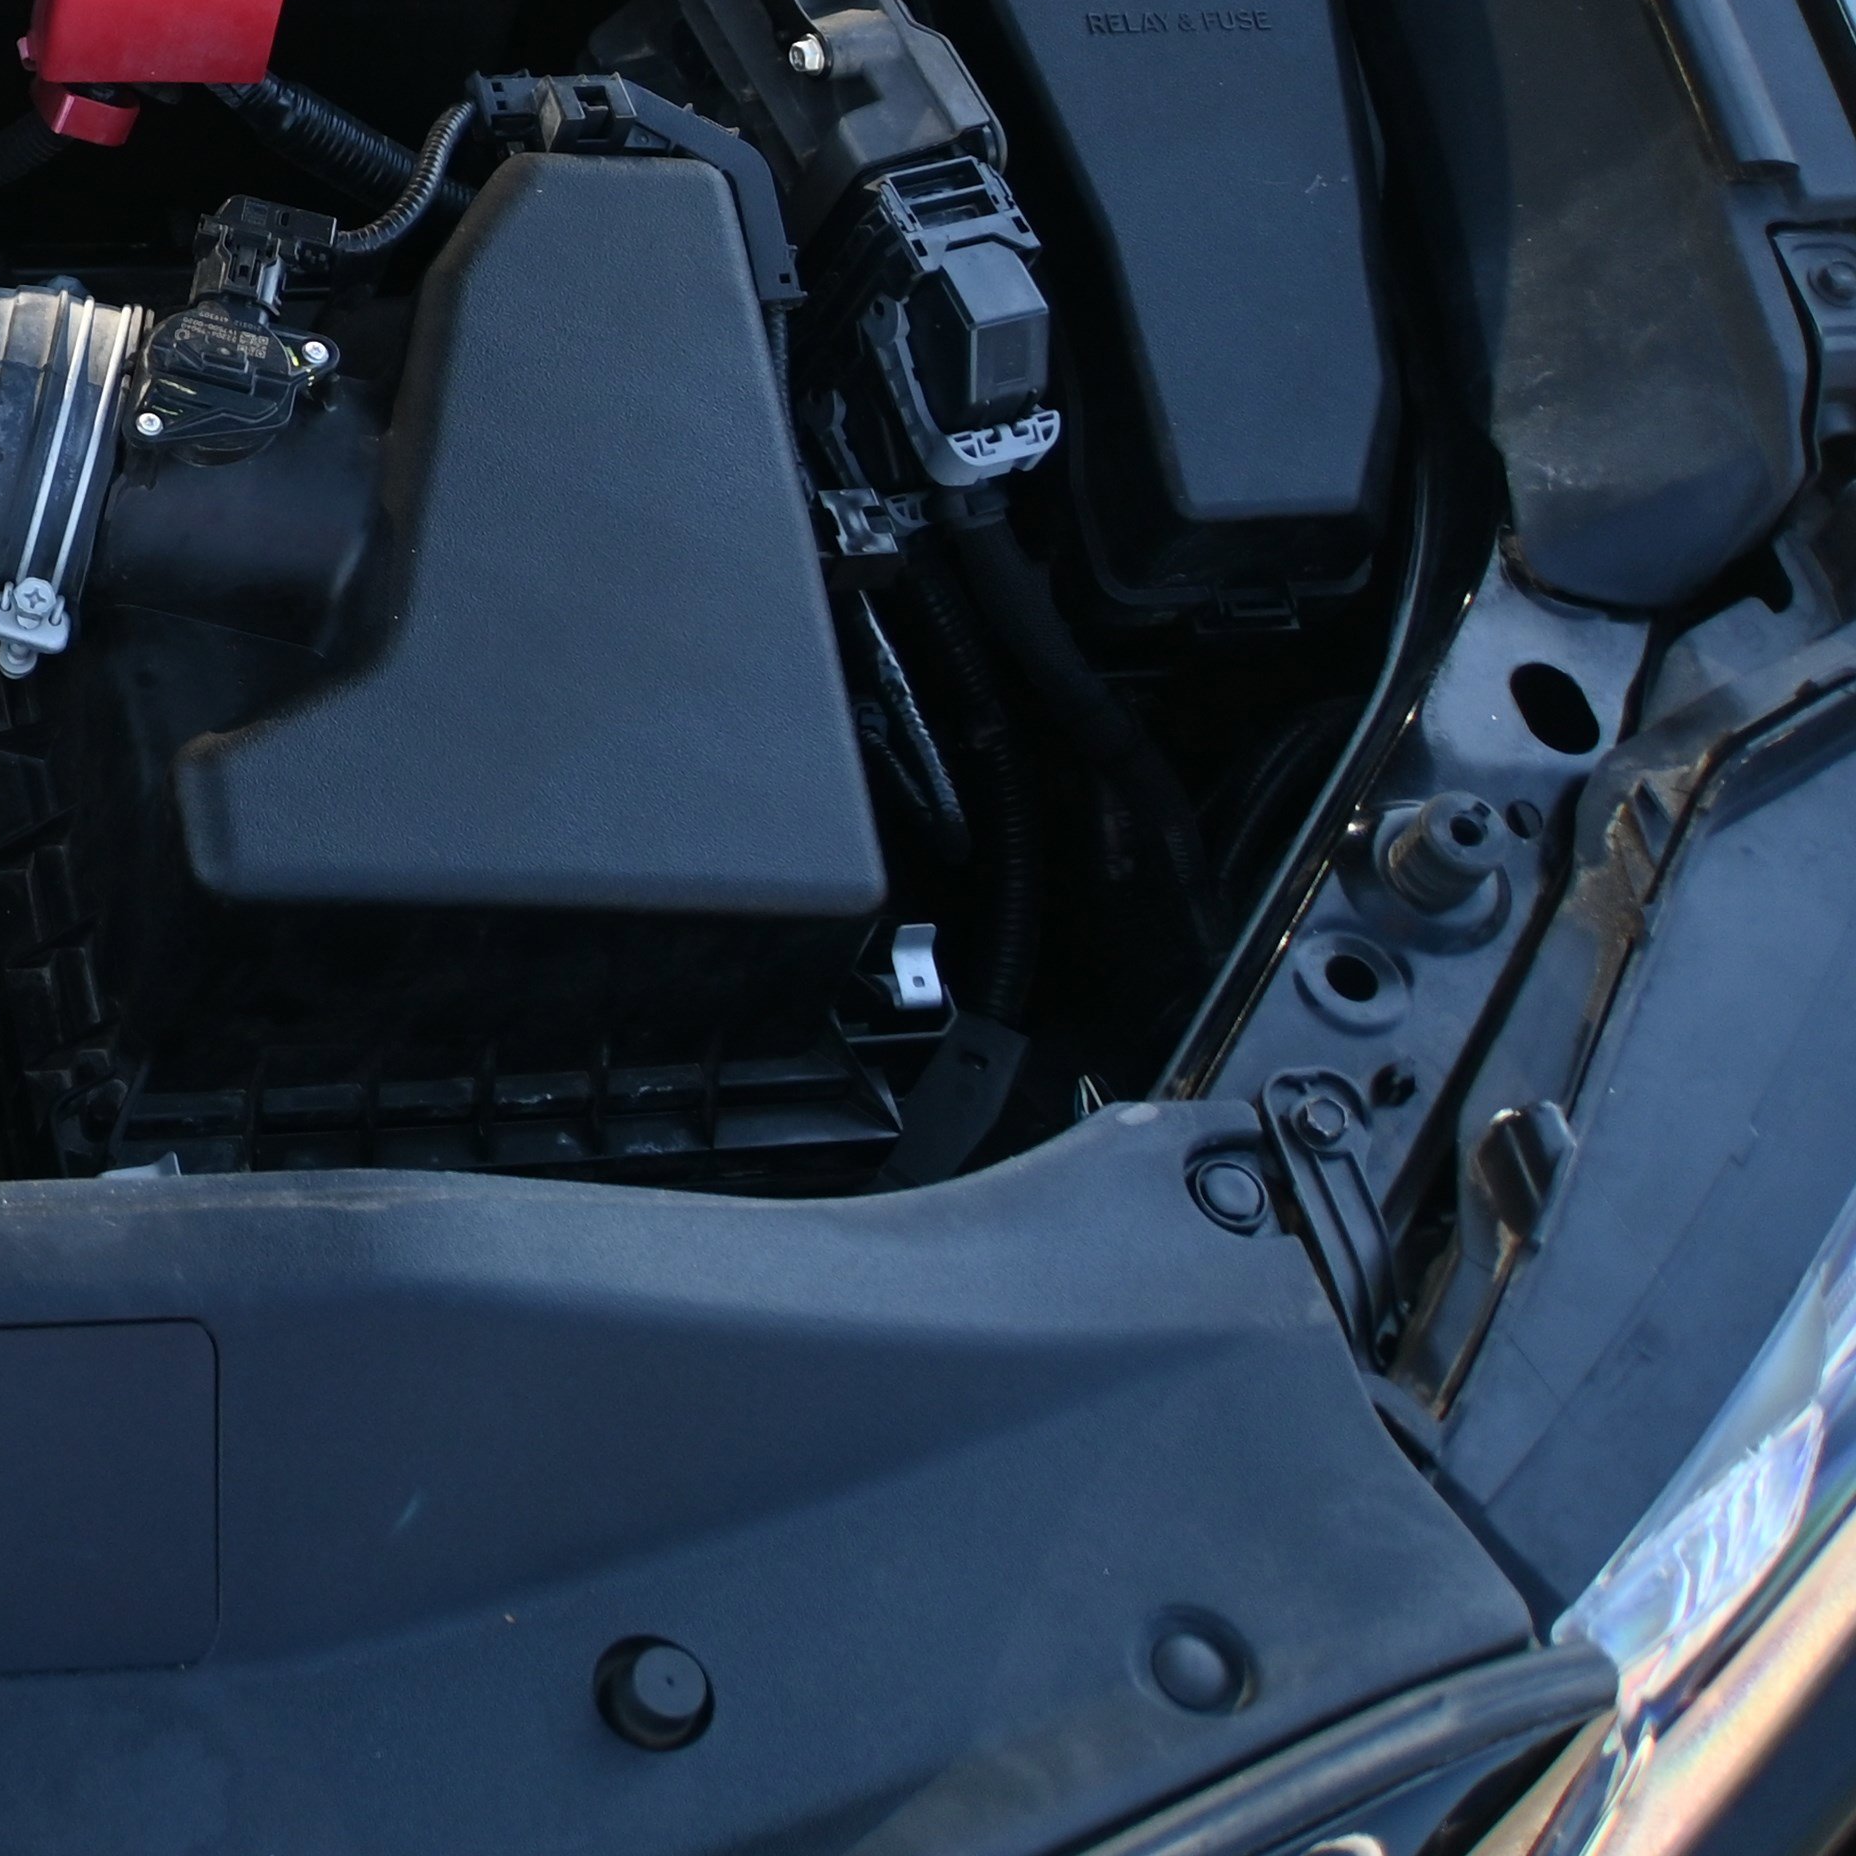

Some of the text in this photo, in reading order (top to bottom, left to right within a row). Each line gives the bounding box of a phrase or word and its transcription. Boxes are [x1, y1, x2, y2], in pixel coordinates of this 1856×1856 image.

[1086, 10, 1271, 34] RELAY & FUSE
